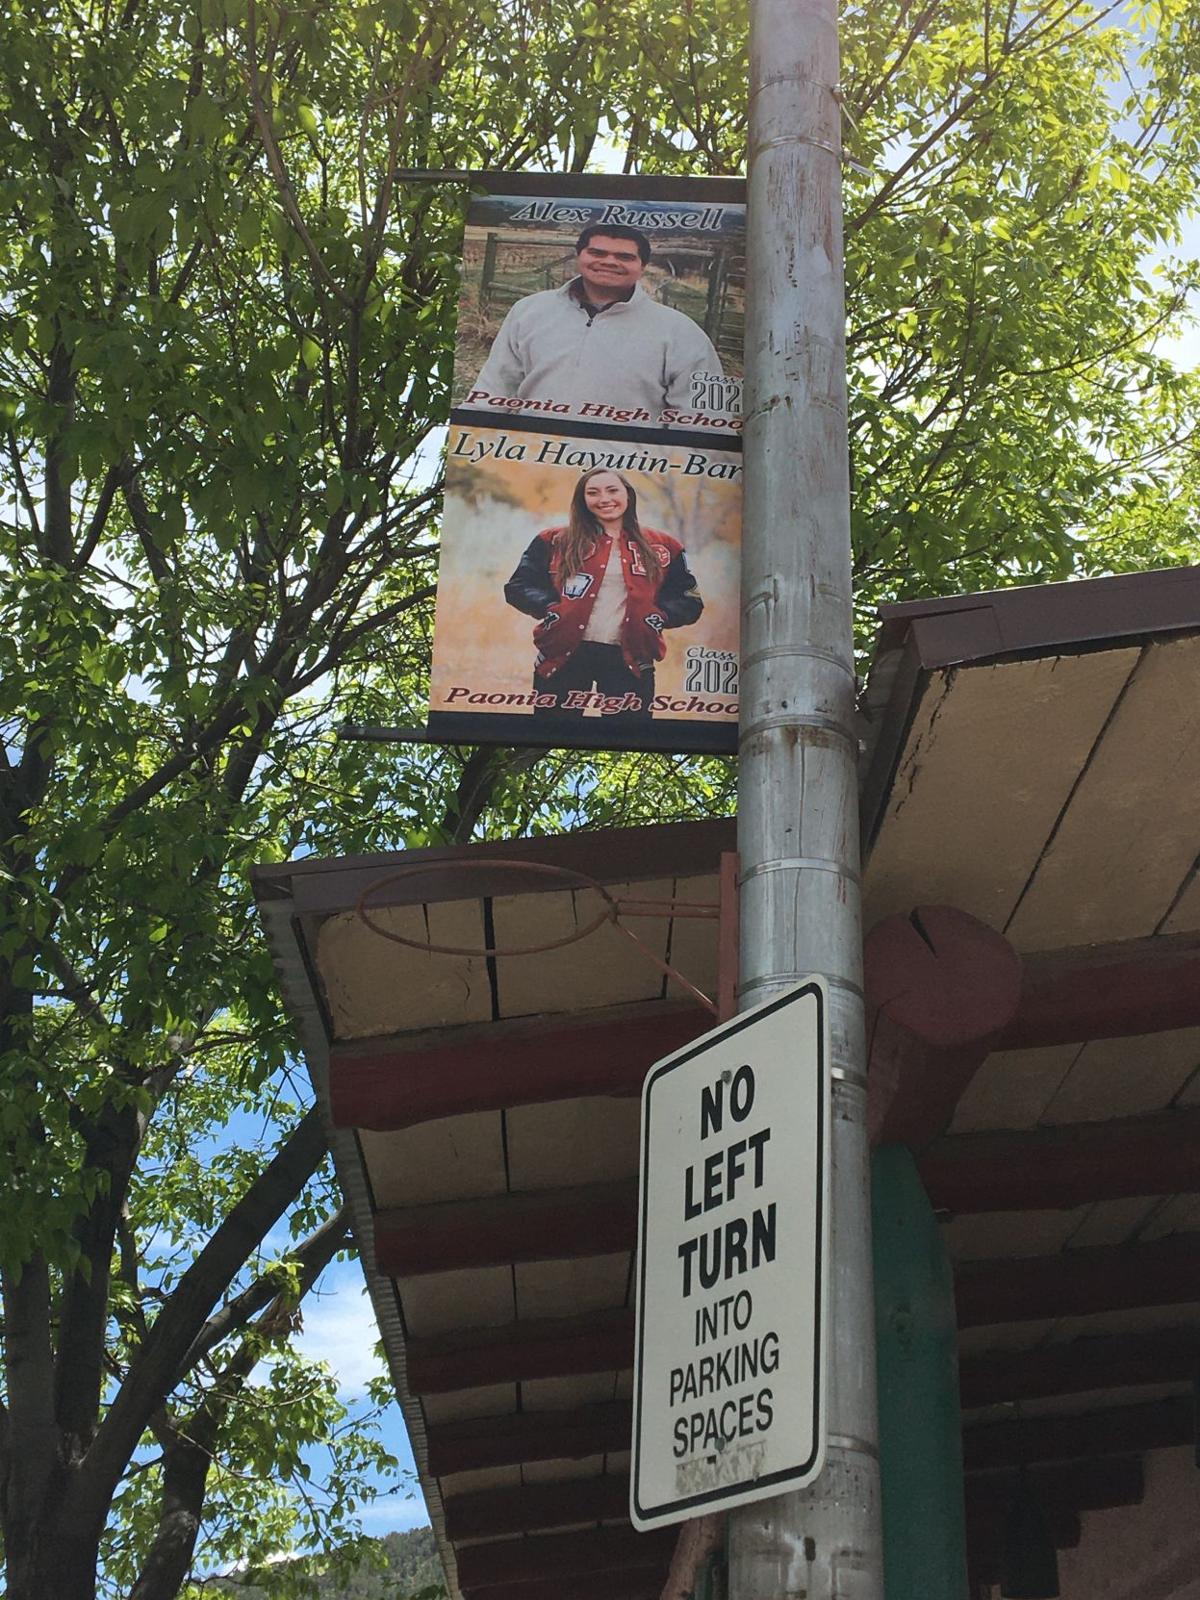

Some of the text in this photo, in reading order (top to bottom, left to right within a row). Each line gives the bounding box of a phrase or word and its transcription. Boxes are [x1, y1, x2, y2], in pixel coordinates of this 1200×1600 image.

[511, 201, 723, 231] Alex Russell
[691, 371, 736, 384] Class
[691, 381, 740, 413] 202
[465, 391, 743, 430] Paonia High Schoo
[452, 432, 743, 479] Lyla Hayutin-Bar
[686, 646, 736, 660] Class
[686, 658, 738, 695] 202
[444, 687, 739, 714] Paonia High Schoo
[701, 1064, 755, 1140] NO
[685, 1127, 771, 1221] LEFT
[678, 1202, 777, 1298] TURN
[695, 1289, 752, 1347] INTO
[669, 1331, 779, 1408] PARKING
[673, 1388, 774, 1458] SPACES
